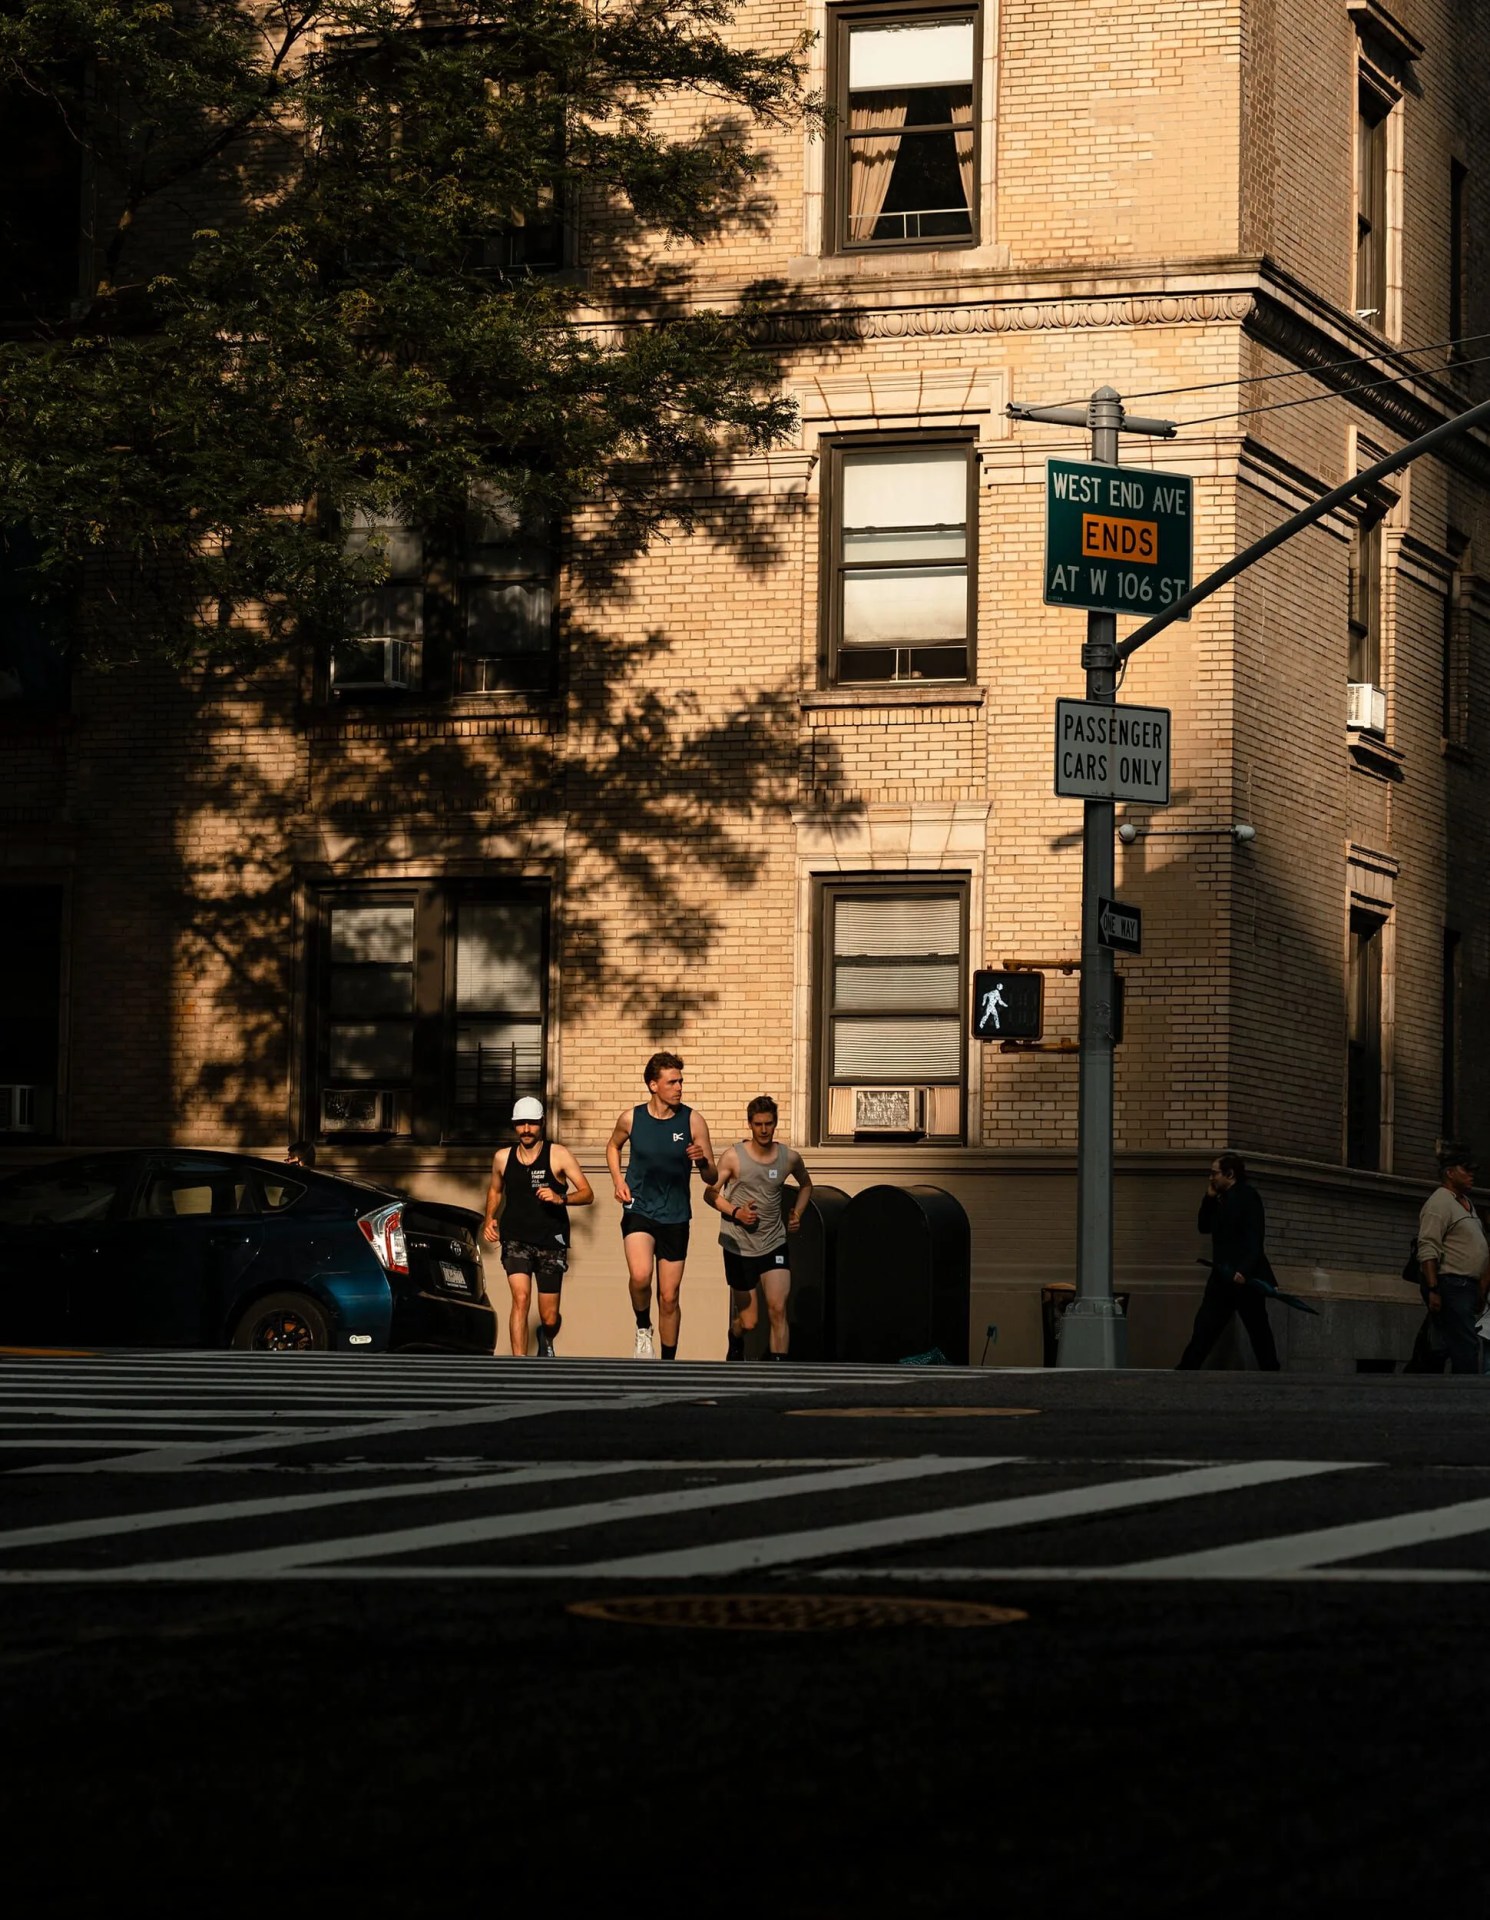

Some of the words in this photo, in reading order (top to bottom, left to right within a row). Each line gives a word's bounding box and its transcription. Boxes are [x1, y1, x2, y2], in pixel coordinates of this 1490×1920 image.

[1053, 472, 1102, 504] WEST
[1110, 479, 1145, 510] END
[1152, 486, 1186, 516] AVE
[1087, 521, 1153, 556] ENDS
[1051, 564, 1080, 592] AT
[1089, 568, 1107, 596] W
[1117, 572, 1153, 602] 106
[1159, 577, 1186, 604] ST
[1064, 714, 1162, 749] PASSENGER
[1063, 752, 1107, 781] CARS
[1120, 757, 1162, 786] ONLY
[1104, 914, 1115, 934] ONE
[1121, 919, 1135, 938] WAY
